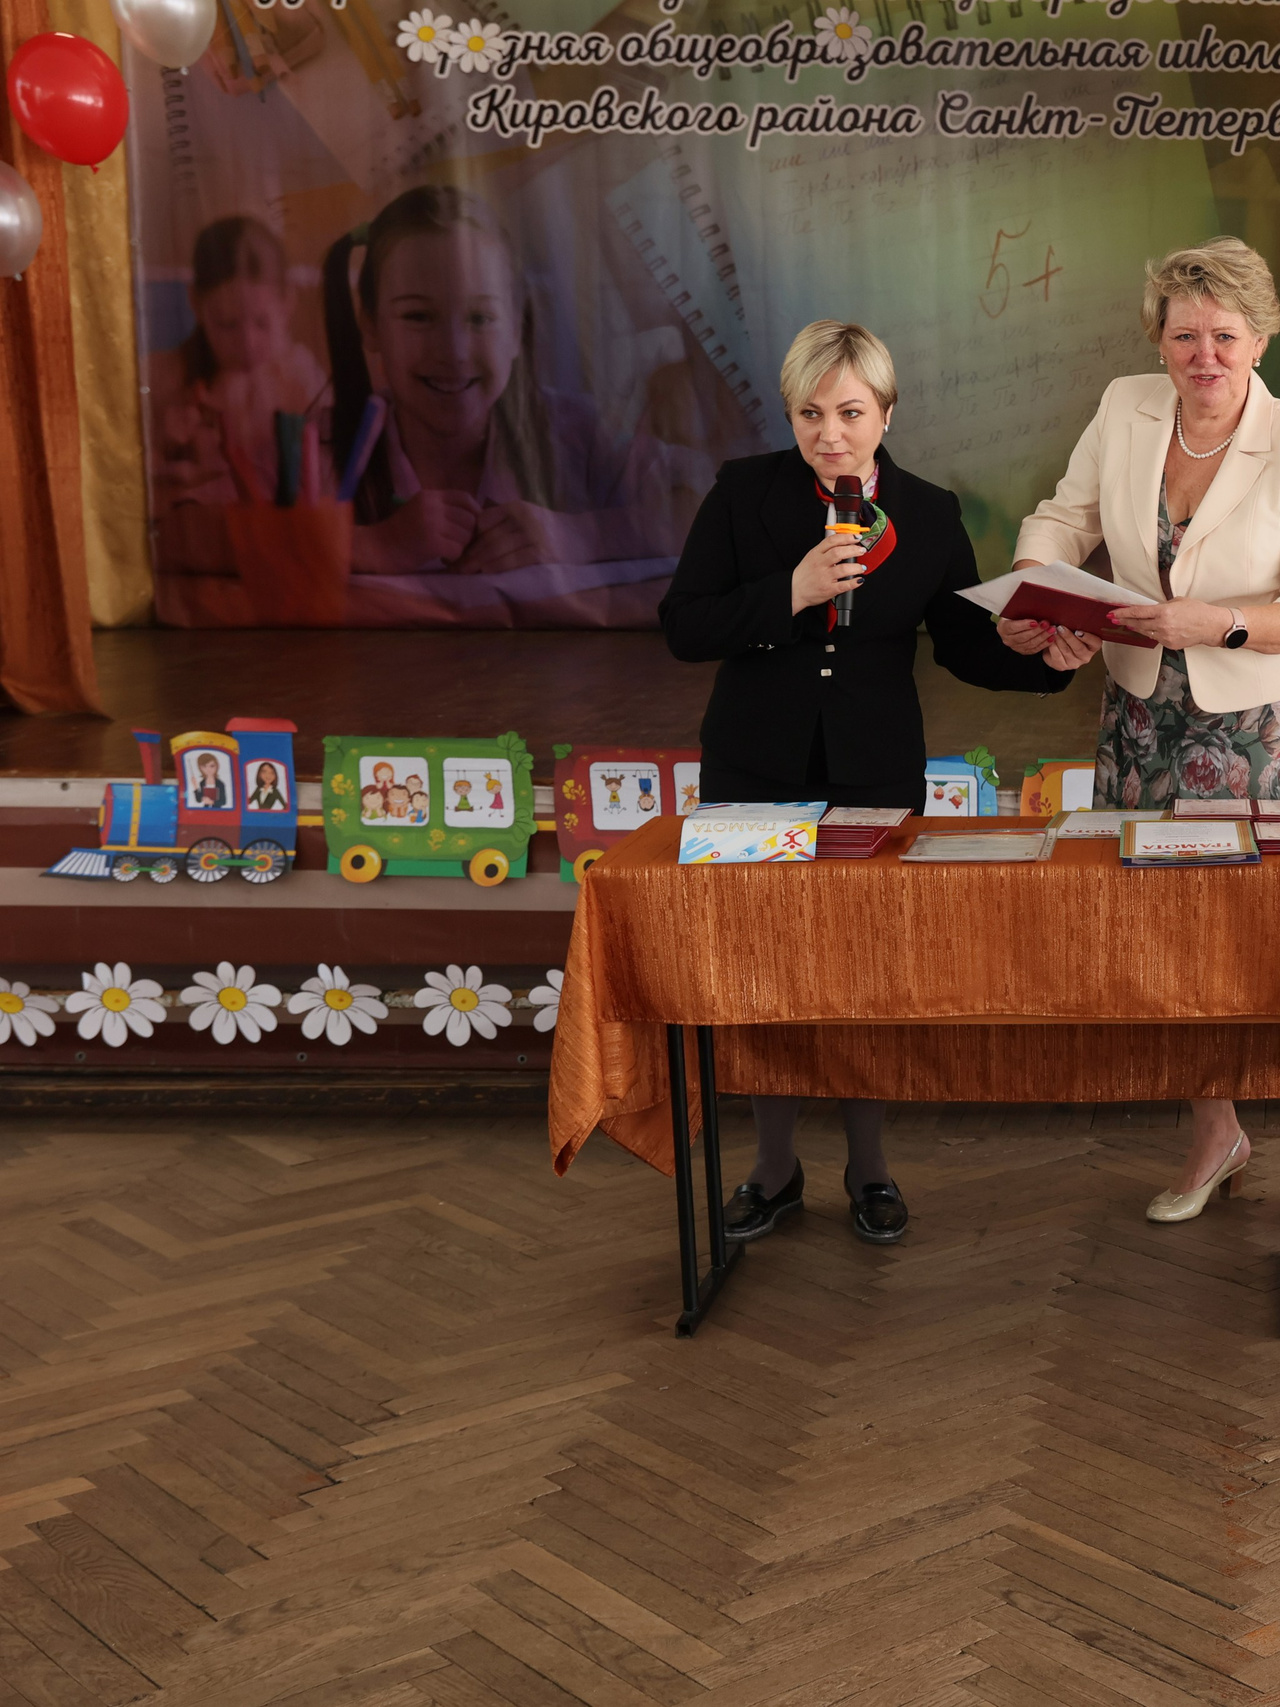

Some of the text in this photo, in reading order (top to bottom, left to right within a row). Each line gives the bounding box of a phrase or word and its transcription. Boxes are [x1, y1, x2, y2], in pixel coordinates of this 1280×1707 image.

[438, 34, 608, 77] дняя
[472, 88, 744, 146] Кировского
[750, 97, 920, 148] района
[979, 218, 1063, 319] 5+
[693, 822, 777, 833] ГРАМОТА
[1142, 842, 1234, 850] ГРАМОТА
